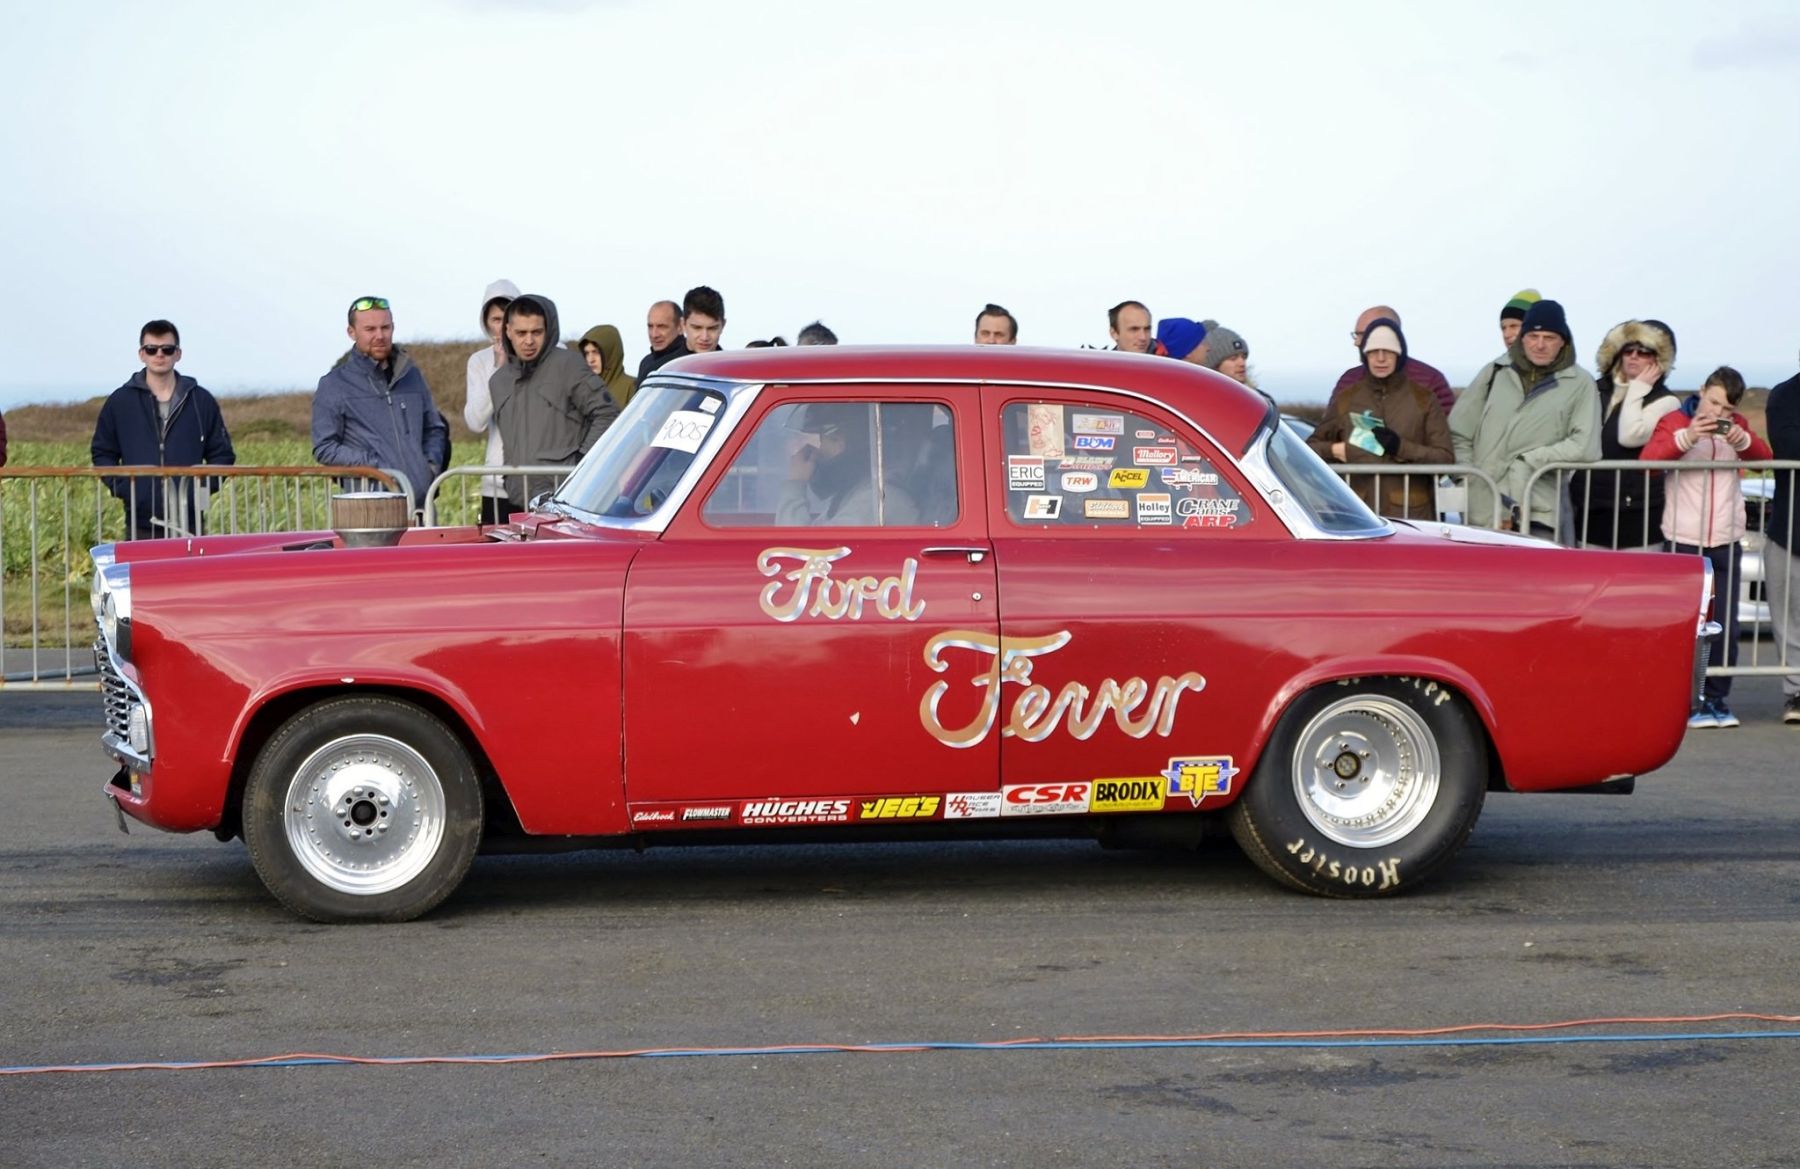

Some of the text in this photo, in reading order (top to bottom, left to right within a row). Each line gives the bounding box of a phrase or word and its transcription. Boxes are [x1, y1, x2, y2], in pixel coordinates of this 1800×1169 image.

[1137, 449, 1175, 462] Mallory
[1010, 466, 1044, 479] ERIC
[1066, 476, 1093, 485] TRW
[1139, 503, 1170, 513] Holley
[1184, 515, 1237, 527] ARP
[757, 546, 926, 622] Ford
[919, 629, 1206, 750] Fever
[1006, 784, 1089, 805] CSR
[1095, 781, 1161, 802] BRODIX
[633, 811, 675, 822] Edelbrock
[682, 807, 731, 821] FLOWMASTER
[743, 815, 848, 824] CONVERTERS
[1286, 838, 1402, 890] Hoosier
